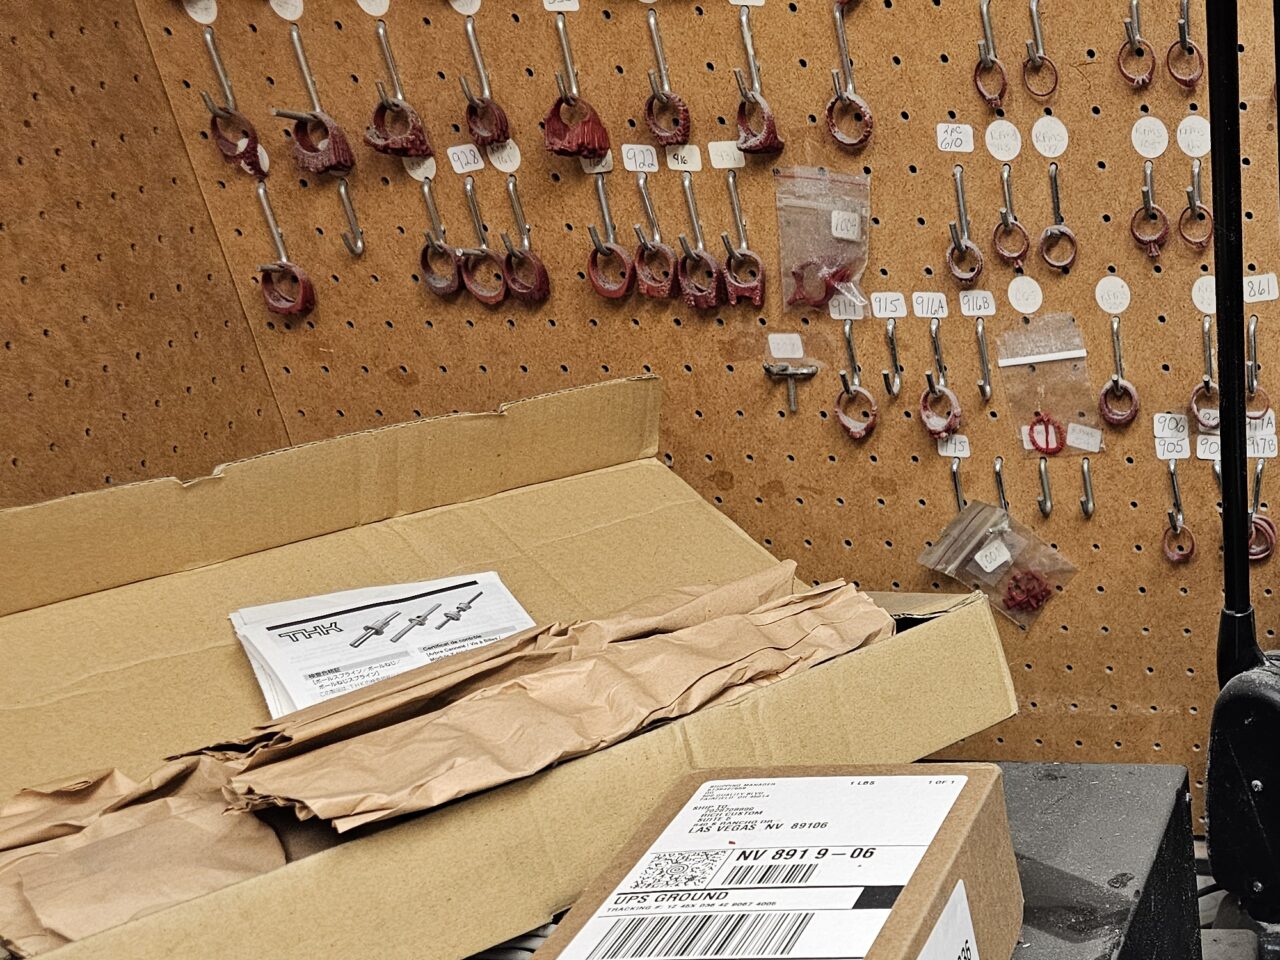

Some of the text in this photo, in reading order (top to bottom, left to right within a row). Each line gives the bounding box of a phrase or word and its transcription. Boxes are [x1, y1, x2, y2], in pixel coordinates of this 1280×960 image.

[453, 149, 479, 169] 928
[626, 149, 656, 169] 922
[1247, 280, 1271, 298] 861
[874, 297, 900, 314] 915
[915, 296, 944, 315] 916A
[963, 296, 990, 313] 916B
[1157, 414, 1185, 434] 906
[1157, 438, 1184, 456] 905
[278, 621, 344, 643] THK
[688, 825, 713, 833] LAS
[716, 823, 756, 832] VEGAS
[790, 821, 829, 830] 89106
[735, 849, 767, 861] NV
[613, 891, 729, 905] UPS GROUND
